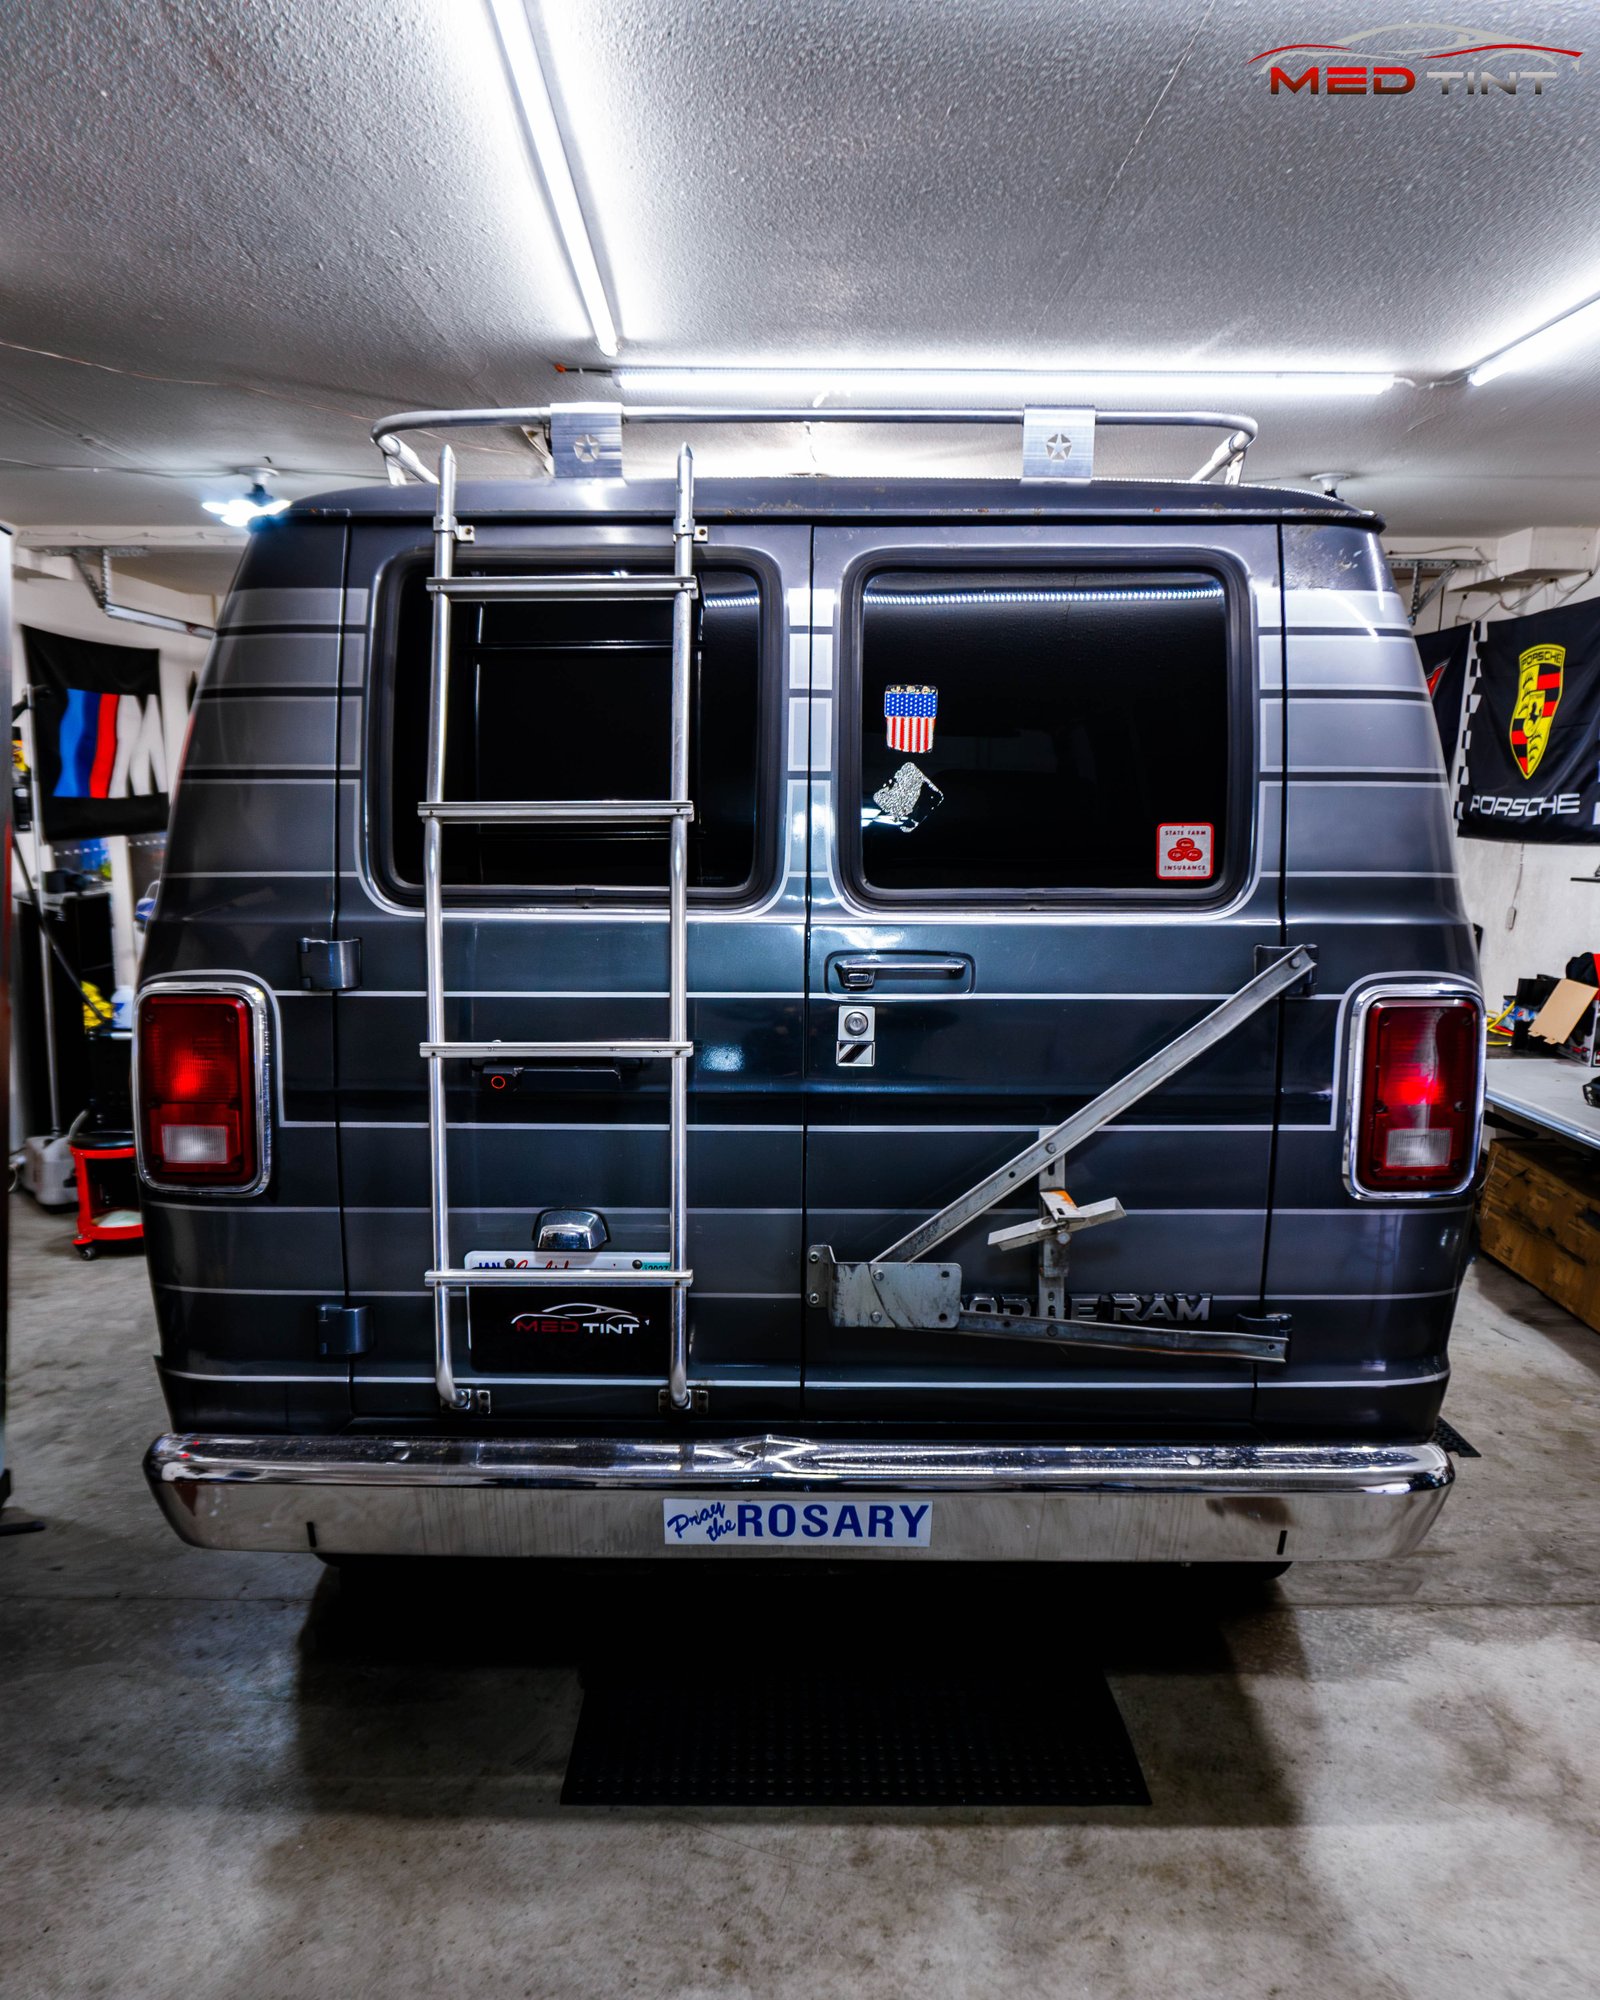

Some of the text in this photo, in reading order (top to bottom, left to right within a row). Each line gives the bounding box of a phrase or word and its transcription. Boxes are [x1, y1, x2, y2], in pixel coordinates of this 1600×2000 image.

[1521, 650, 1563, 665] PORSCHE
[1469, 793, 1580, 817] PORSCHE
[1112, 1293, 1213, 1321] RAM
[516, 1320, 640, 1335] MED TINT
[667, 1502, 929, 1542] Pray the ROSARY
